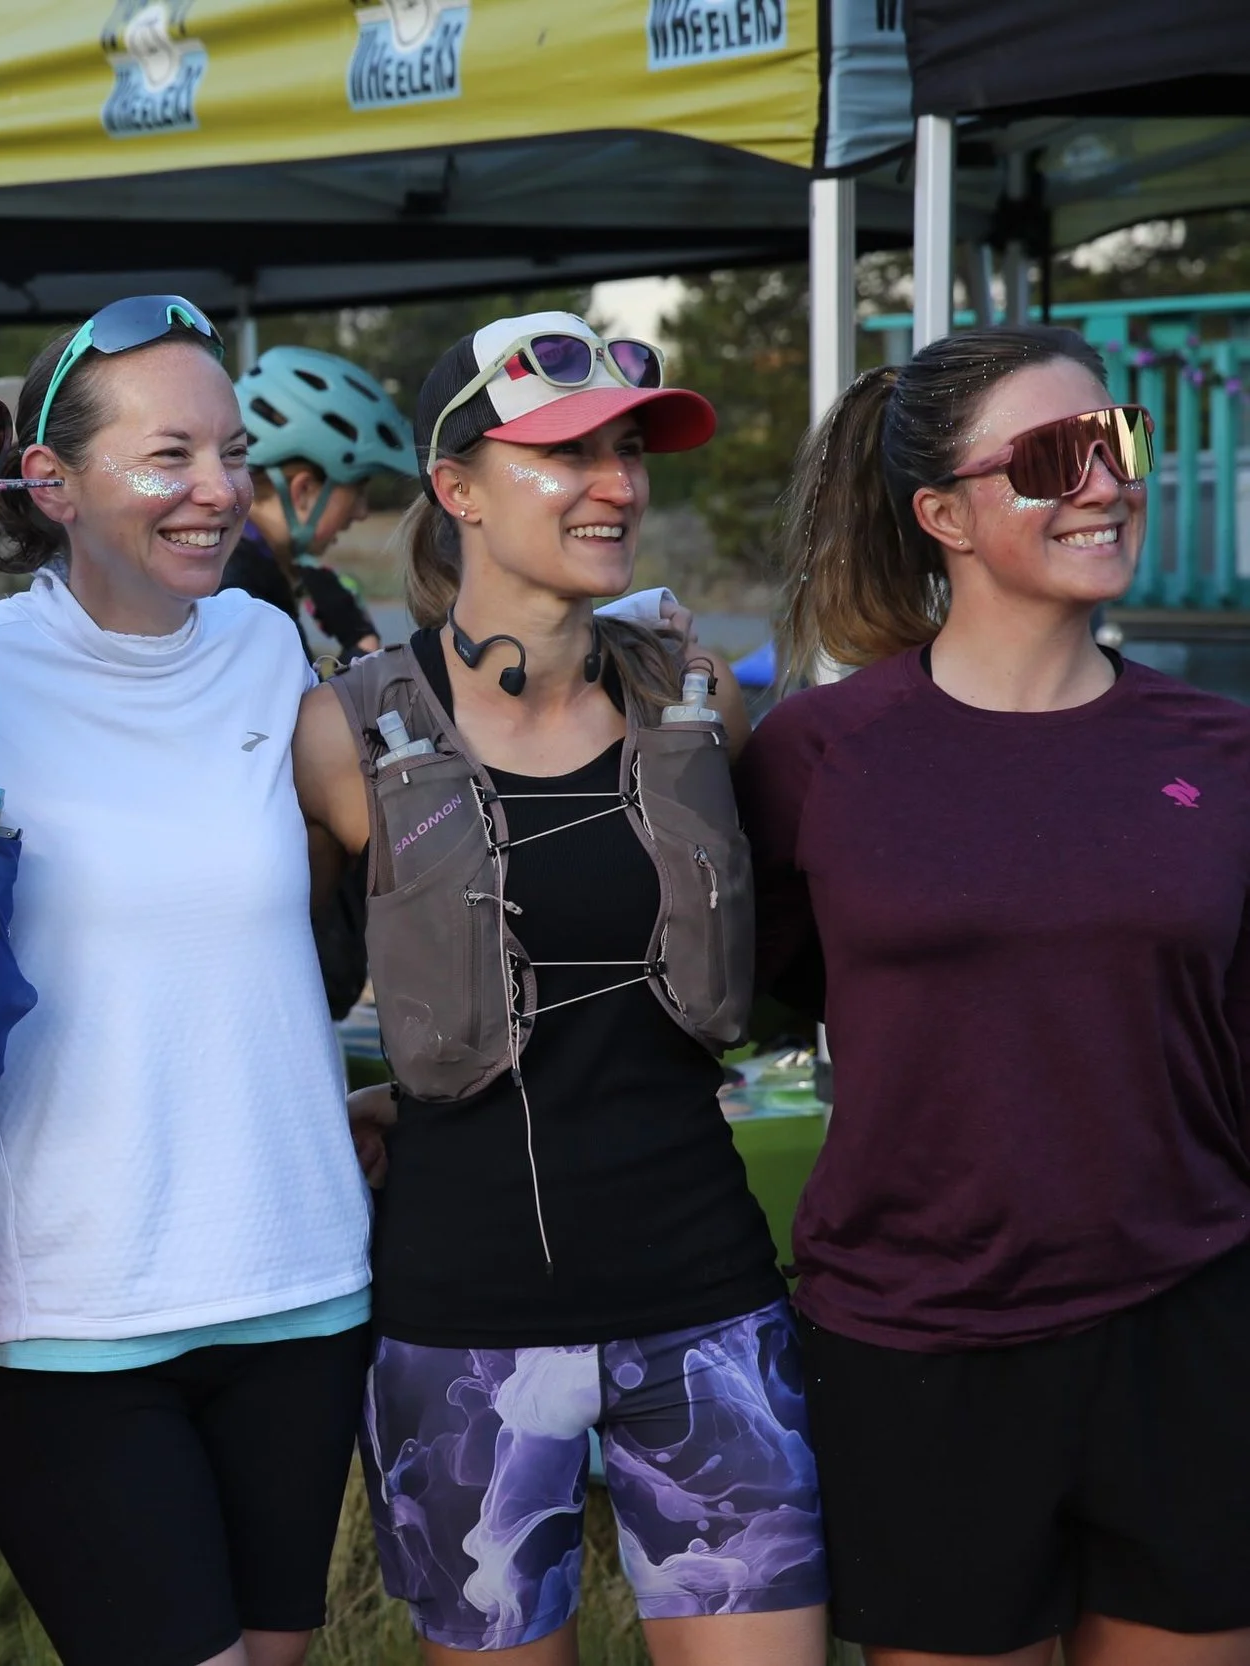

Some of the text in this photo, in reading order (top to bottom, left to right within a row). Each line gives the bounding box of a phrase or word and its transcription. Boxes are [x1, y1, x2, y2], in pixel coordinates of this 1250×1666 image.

[650, 0, 782, 60] WHEELERS
[350, 22, 462, 104] WHEELERS
[394, 793, 462, 856] SALOMON
